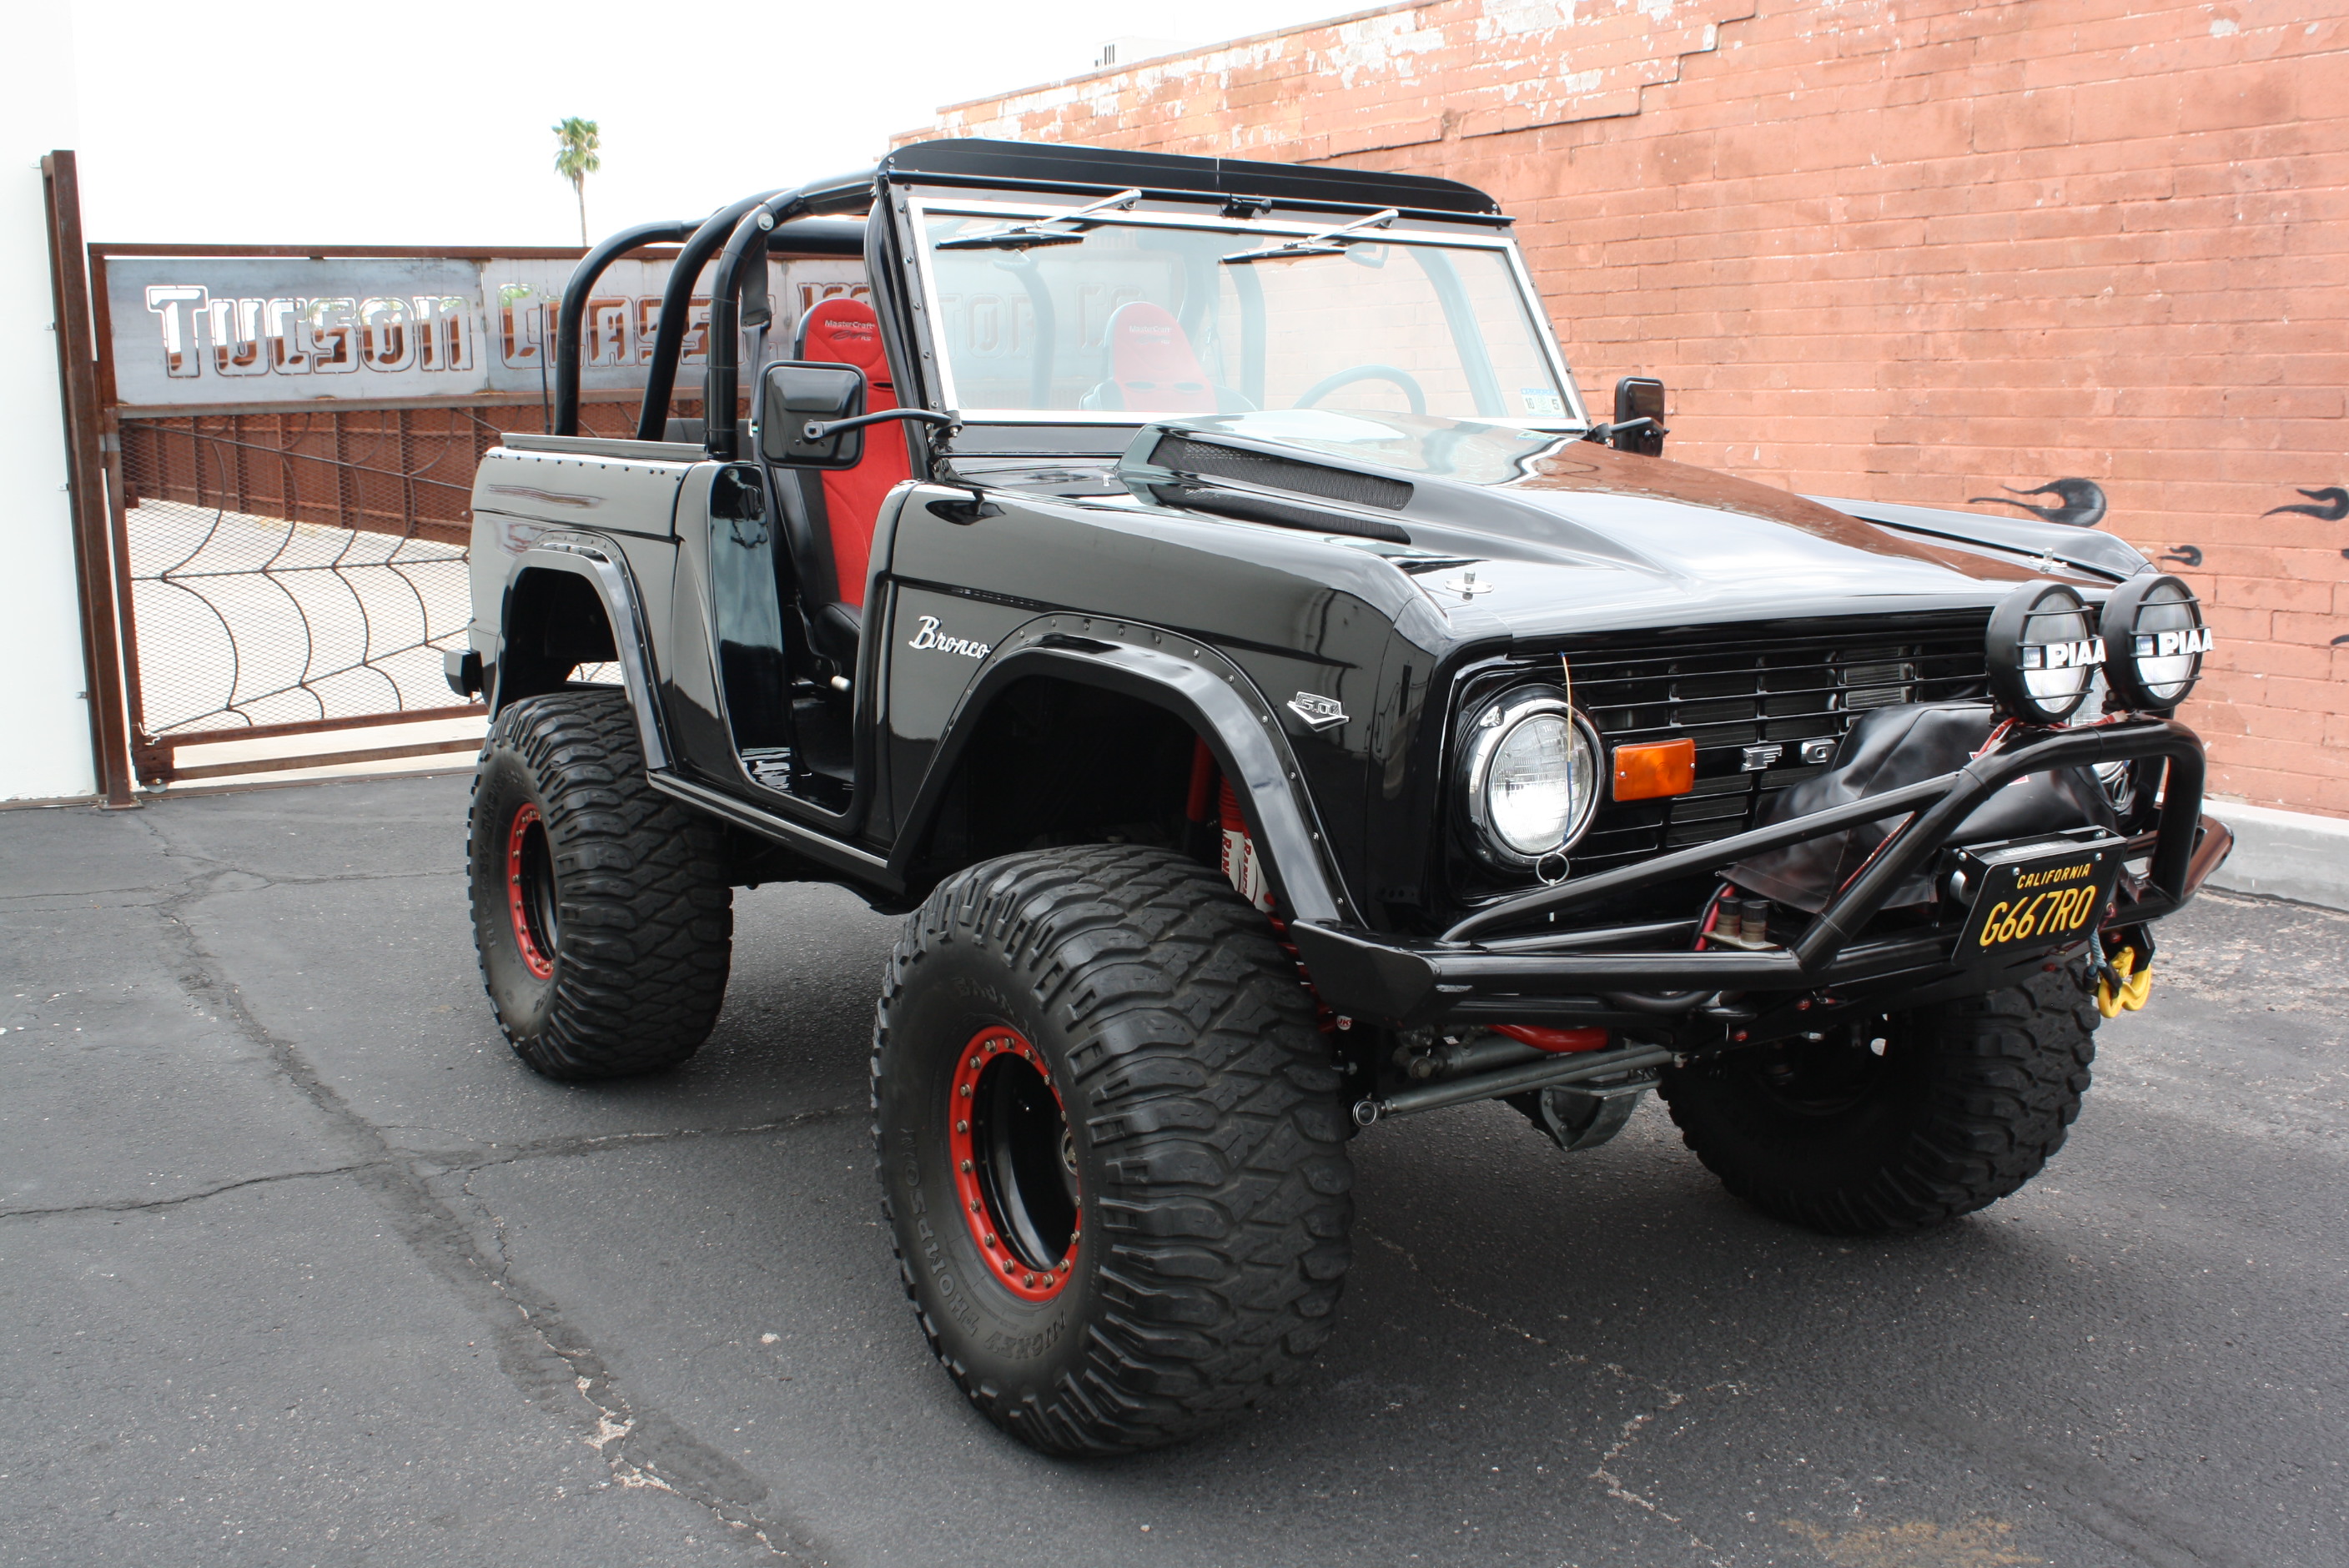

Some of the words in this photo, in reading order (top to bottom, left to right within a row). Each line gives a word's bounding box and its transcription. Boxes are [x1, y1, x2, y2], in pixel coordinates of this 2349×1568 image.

[908, 616, 991, 659] Bronco
[2159, 628, 2213, 656] PIAA
[2046, 639, 2106, 669] PIAA
[2016, 863, 2091, 889] CALIFORNIA
[901, 1128, 979, 1338] THOMPSON
